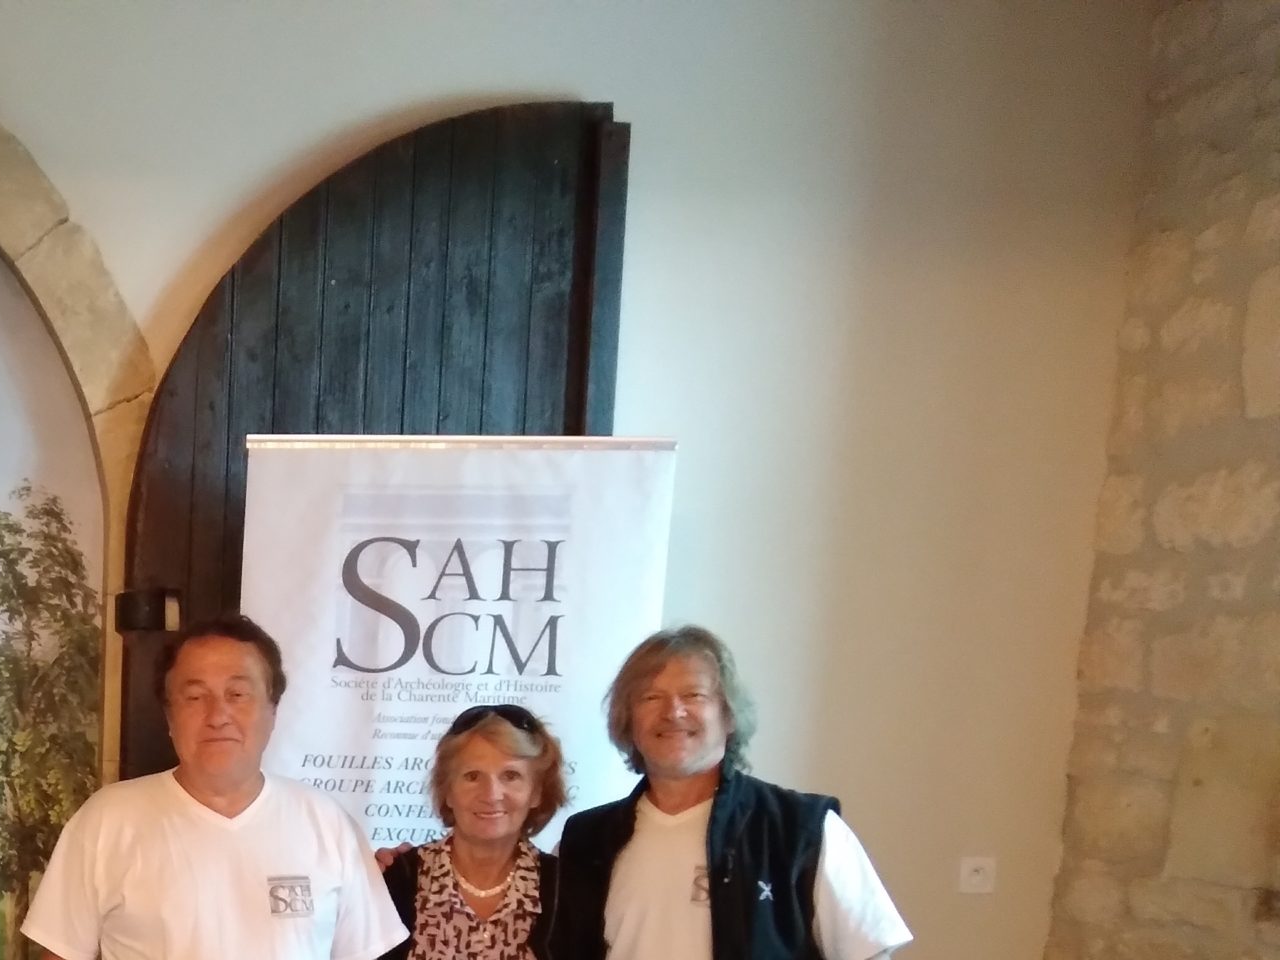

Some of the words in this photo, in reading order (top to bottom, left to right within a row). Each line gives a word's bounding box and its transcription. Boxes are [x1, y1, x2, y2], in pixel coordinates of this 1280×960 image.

[330, 675, 377, 690] Société
[382, 677, 470, 695] d'Archéologie
[477, 681, 489, 691] et
[494, 679, 562, 694] d'Histoire
[361, 691, 376, 702] de
[381, 691, 393, 702] la
[396, 691, 459, 704] Charente
[464, 693, 527, 705] Maritime
[301, 754, 394, 770] FOUILLES
